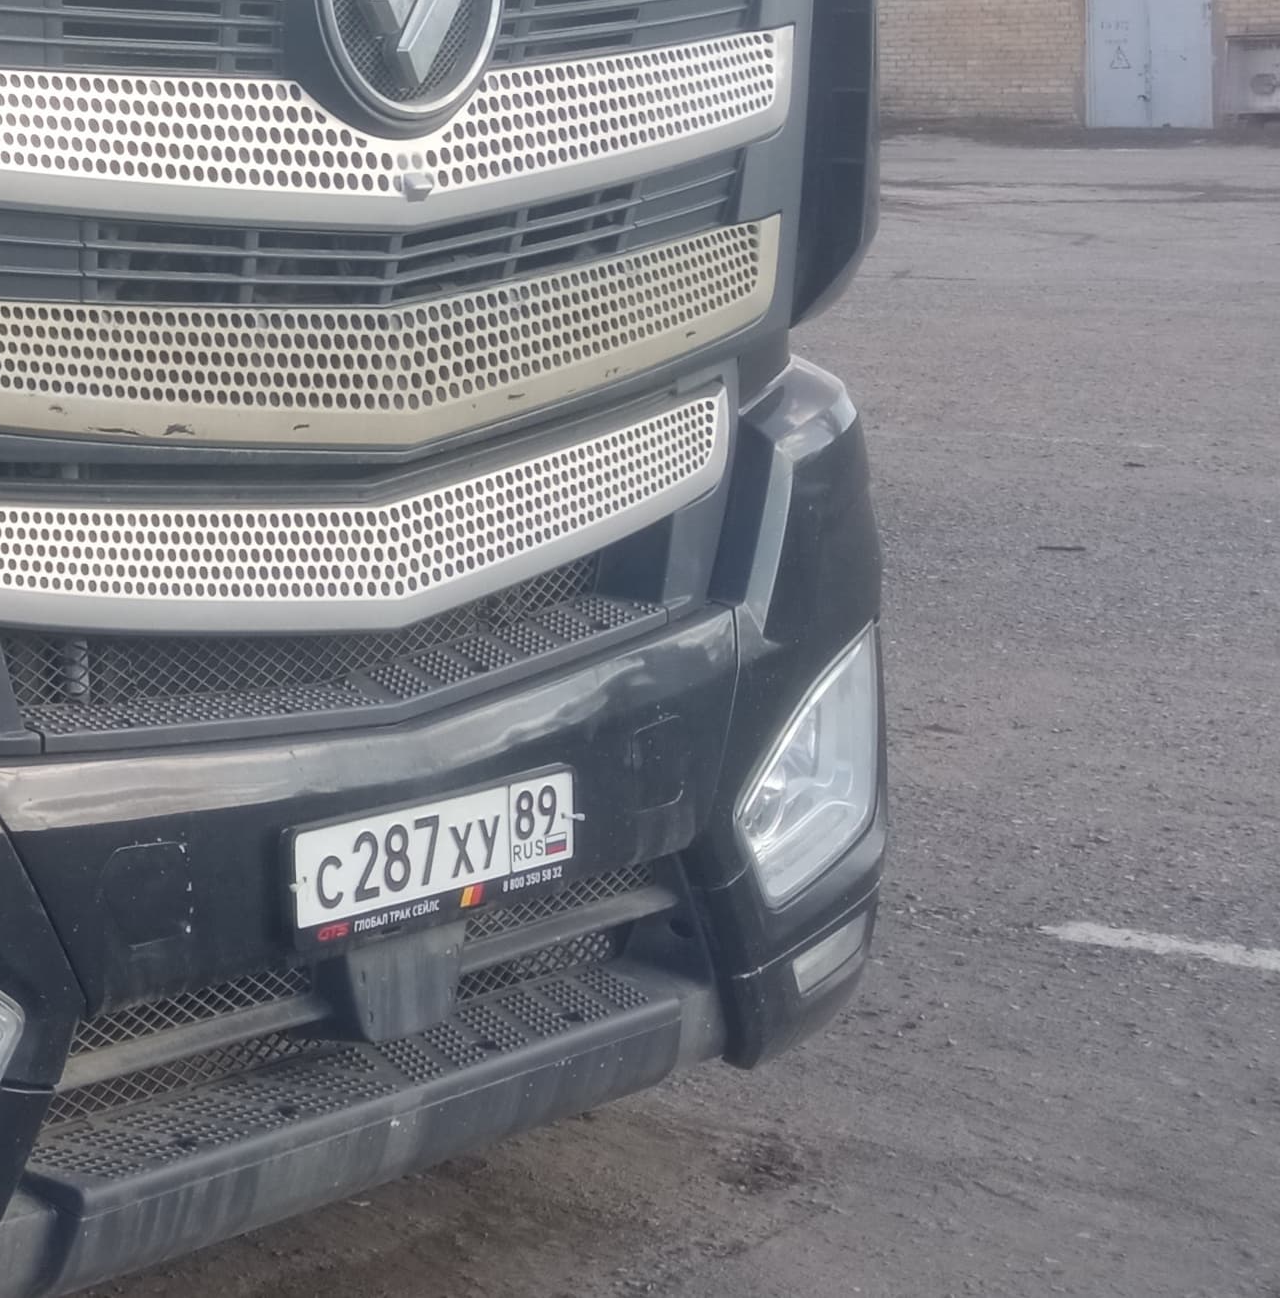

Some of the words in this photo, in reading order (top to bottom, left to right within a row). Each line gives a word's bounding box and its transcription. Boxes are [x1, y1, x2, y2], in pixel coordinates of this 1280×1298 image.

[514, 784, 558, 841] 89
[512, 839, 545, 863] RUS
[353, 913, 389, 933] ГЛОБАЛ
[389, 906, 412, 923] ТРАК
[412, 899, 441, 919] СЕЙЛС
[317, 922, 351, 942] GTS
